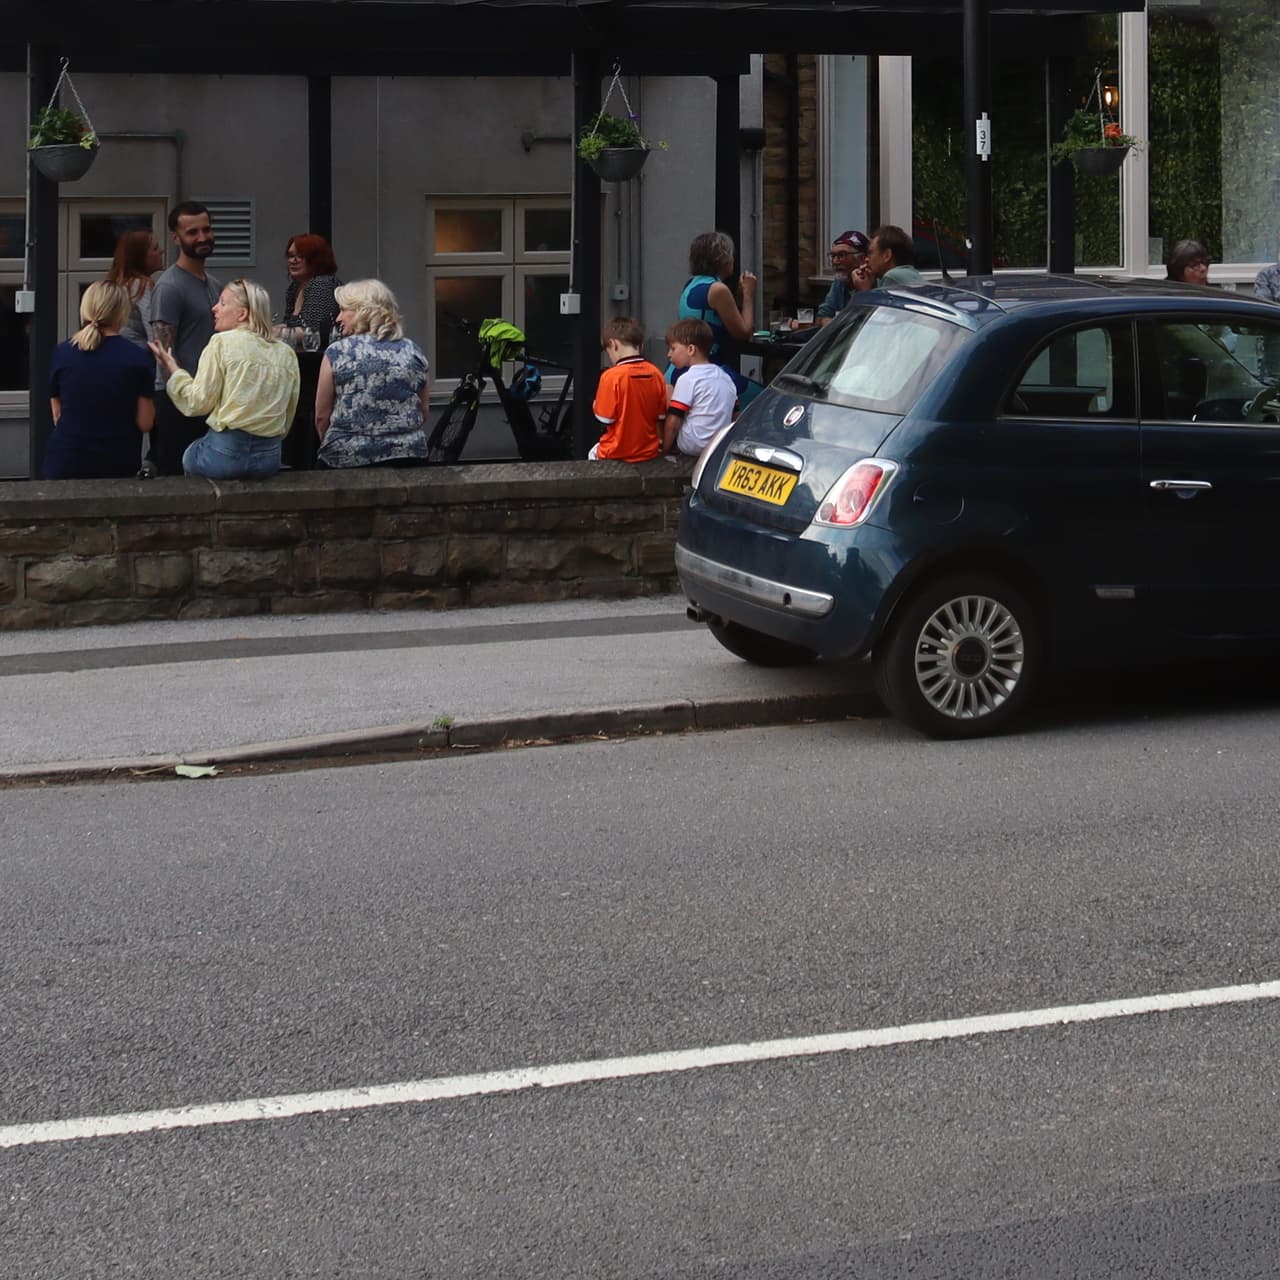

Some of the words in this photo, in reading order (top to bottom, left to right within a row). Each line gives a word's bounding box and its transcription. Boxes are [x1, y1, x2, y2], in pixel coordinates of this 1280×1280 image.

[979, 130, 987, 151] 37
[727, 463, 762, 492] YR63
[756, 472, 792, 501] AKK
